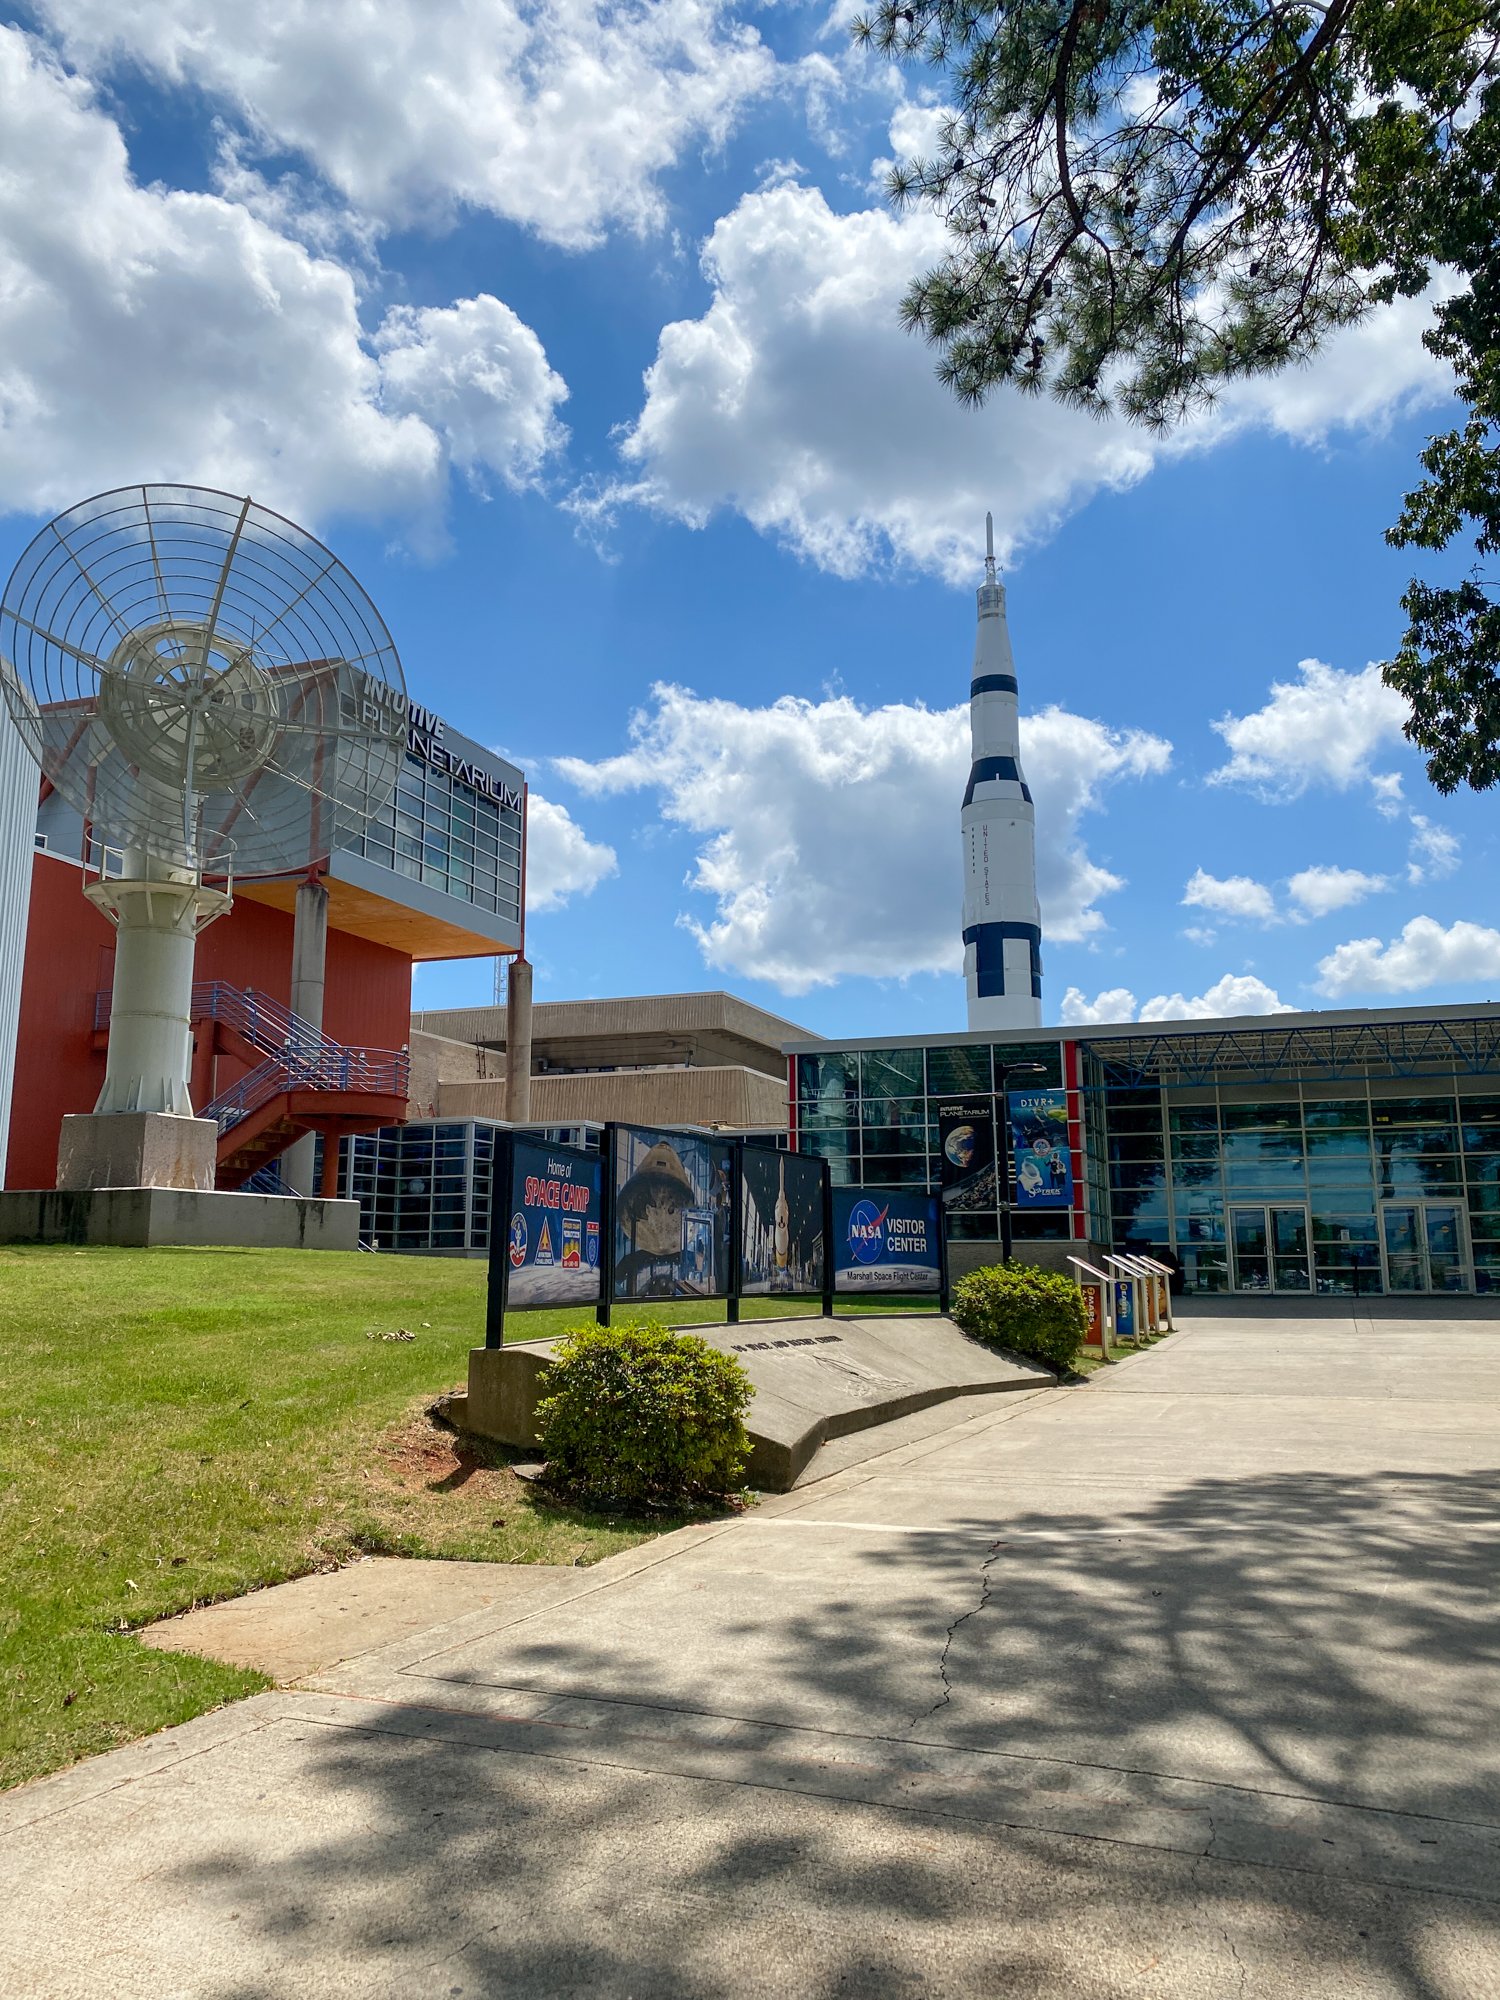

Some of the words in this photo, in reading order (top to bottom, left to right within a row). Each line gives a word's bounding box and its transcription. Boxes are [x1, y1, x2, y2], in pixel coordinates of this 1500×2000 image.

[363, 672, 446, 740] INTUITIVE
[362, 699, 522, 811] PLANETARIUM
[983, 866, 991, 906] STATES
[1020, 1098, 1055, 1107] DIVR+
[547, 1158, 565, 1177] Home
[565, 1163, 573, 1178] of
[524, 1176, 560, 1209] SPACE
[560, 1183, 590, 1213] CAMP
[851, 1224, 882, 1239] NASA
[886, 1218, 925, 1235] VISITOR
[887, 1237, 927, 1253] CENTER
[847, 1271, 872, 1280] Marshall
[874, 1272, 892, 1281] Space
[893, 1272, 909, 1282] Flight
[910, 1272, 928, 1280] Center
